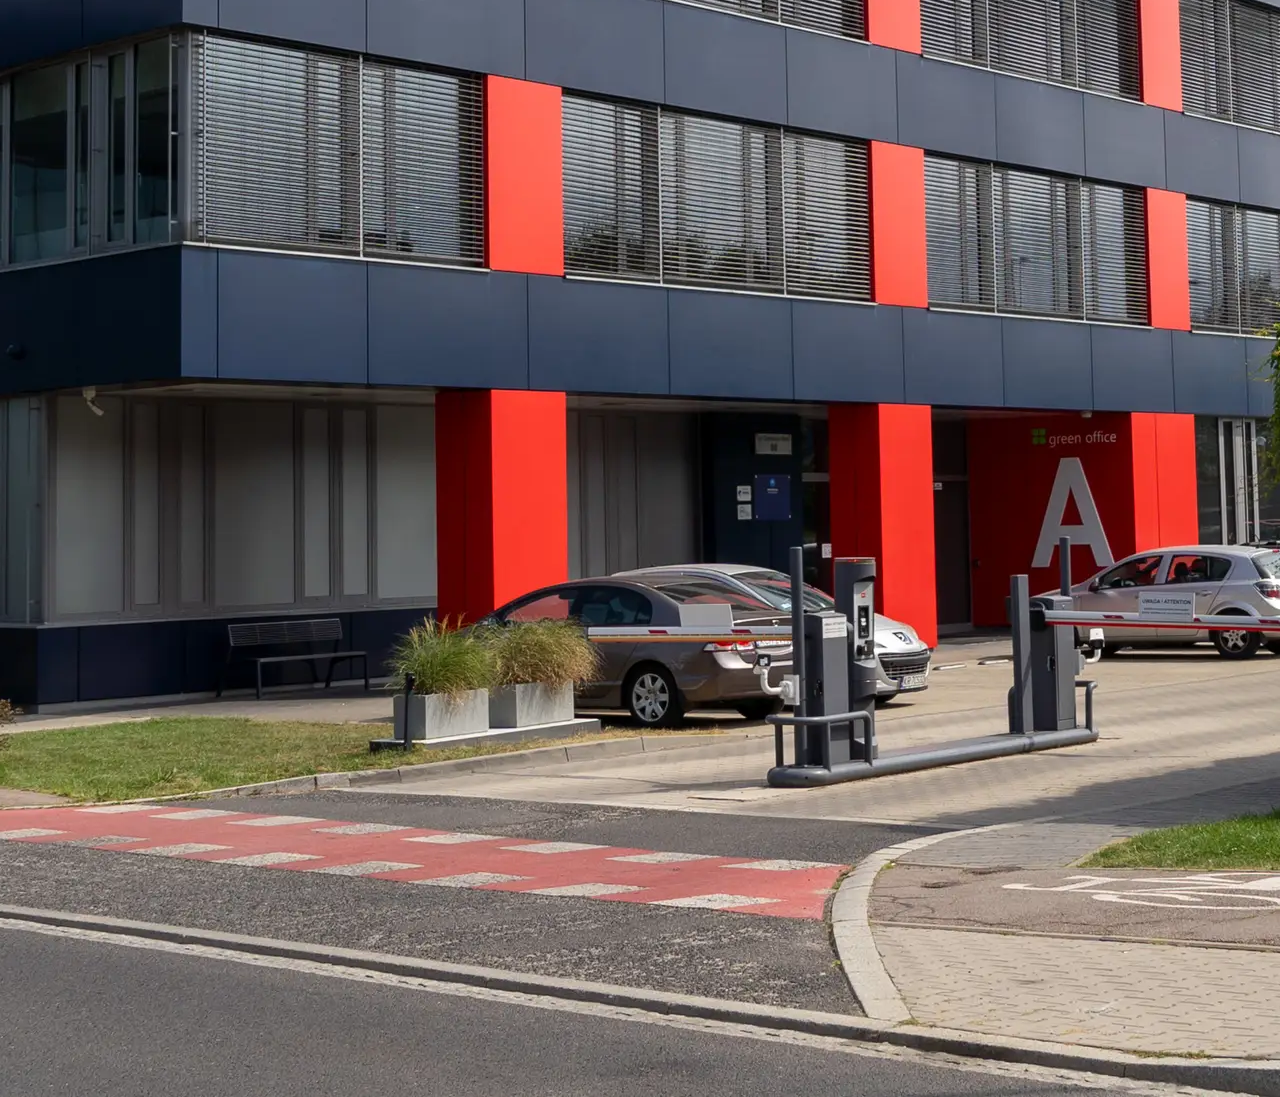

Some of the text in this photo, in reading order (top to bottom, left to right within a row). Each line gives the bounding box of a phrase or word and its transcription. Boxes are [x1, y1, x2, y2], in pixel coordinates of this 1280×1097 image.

[1048, 430, 1117, 448] green office
[1031, 457, 1115, 568] A
